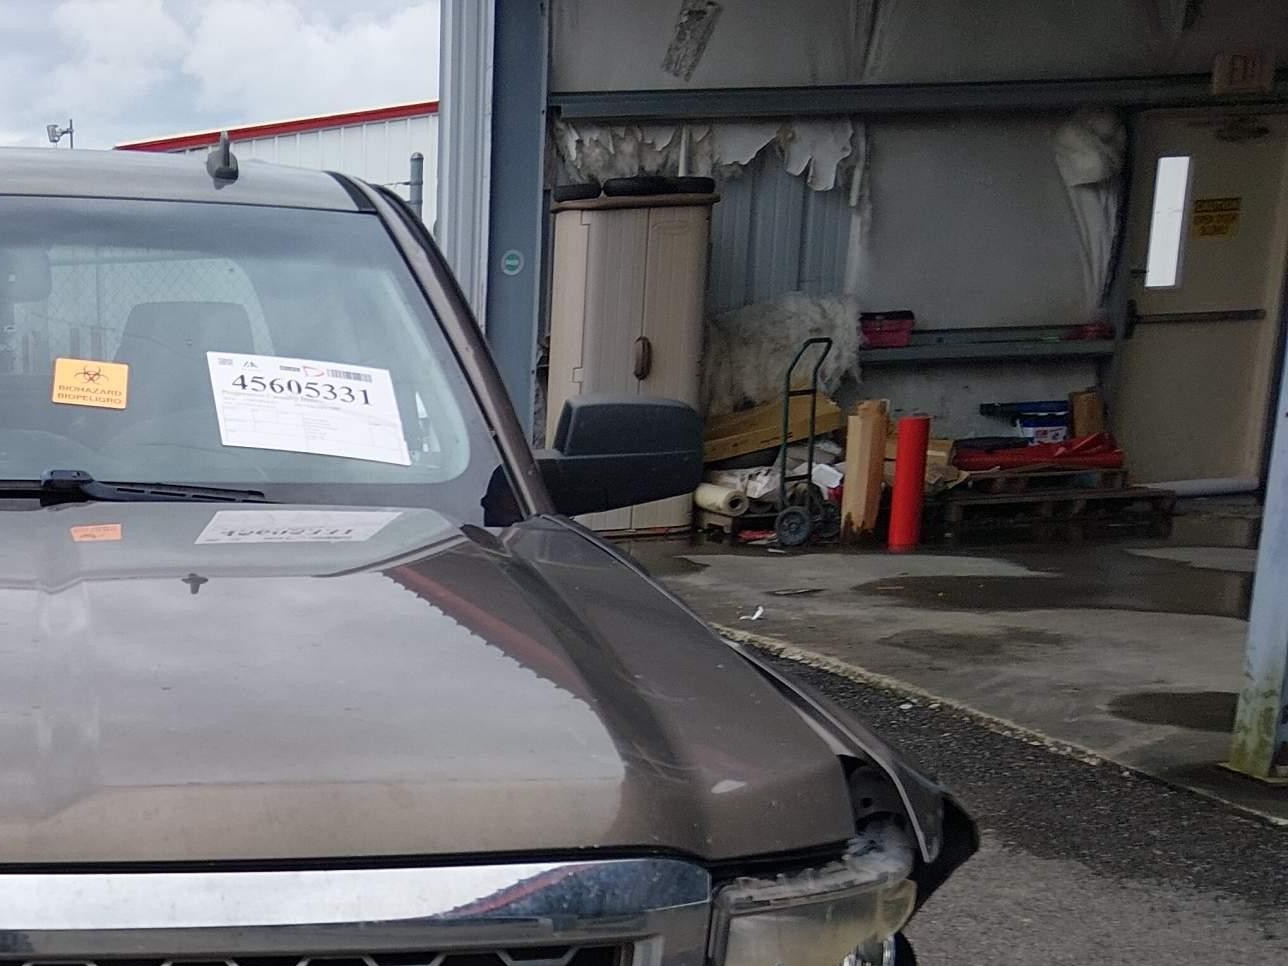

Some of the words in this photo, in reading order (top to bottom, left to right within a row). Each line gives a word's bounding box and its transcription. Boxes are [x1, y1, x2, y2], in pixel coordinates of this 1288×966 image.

[58, 384, 122, 397] BIOHAZARD
[231, 373, 372, 406] 45605331
[57, 392, 122, 405] BIOPELIGRO
